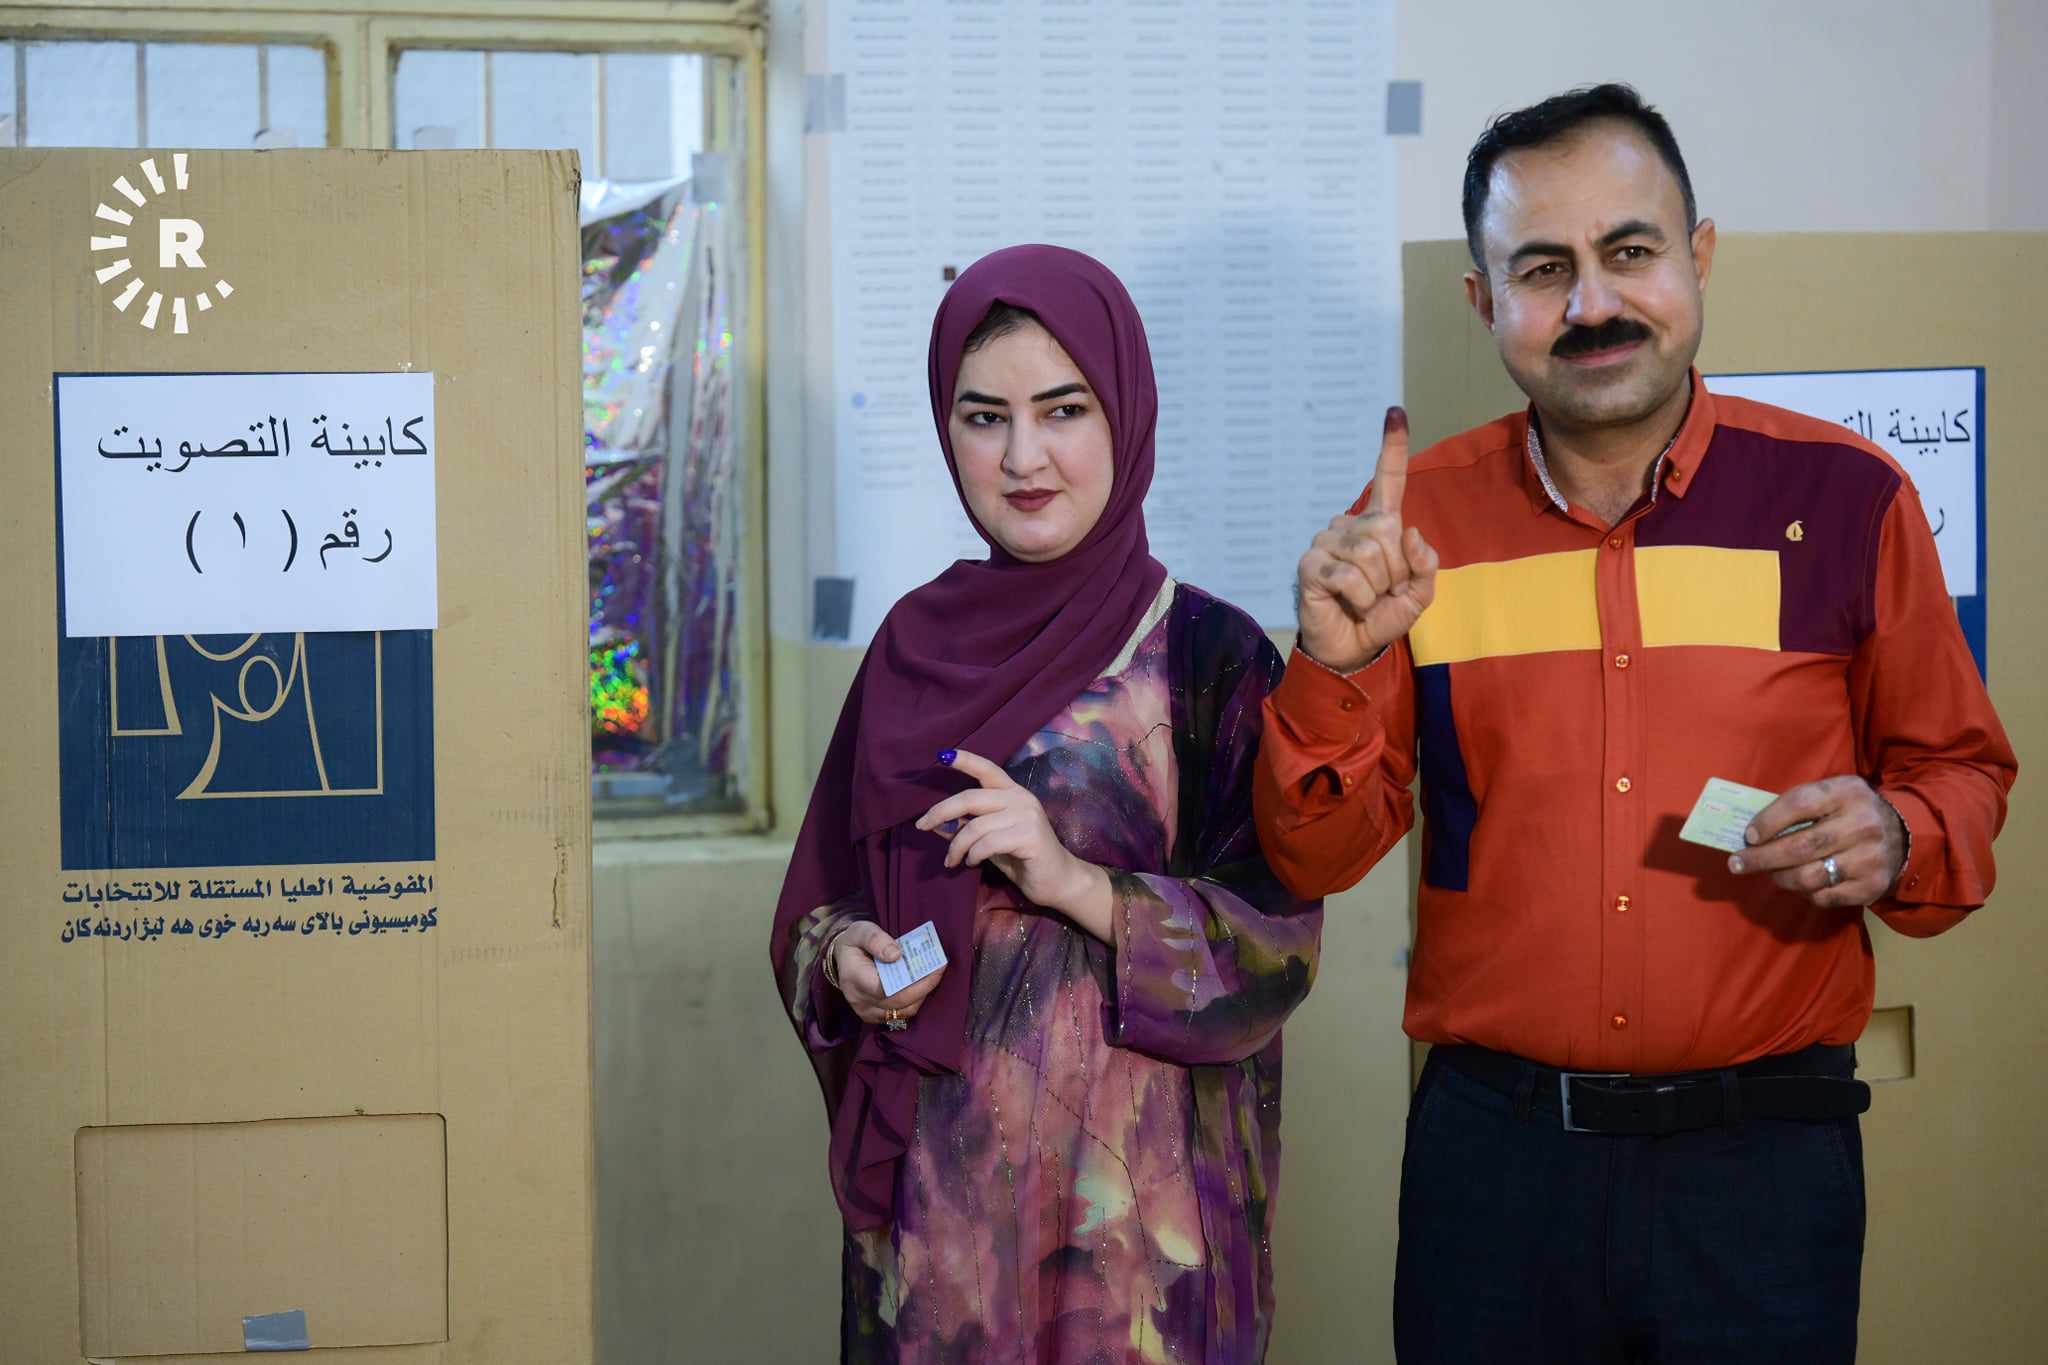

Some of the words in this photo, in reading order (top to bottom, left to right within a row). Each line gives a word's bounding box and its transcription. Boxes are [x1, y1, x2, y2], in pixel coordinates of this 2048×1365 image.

[97, 413, 291, 473] التصويت
[310, 413, 428, 470] كابينة
[1888, 408, 1971, 456] كابينة
[319, 507, 393, 571] رقم
[62, 880, 181, 909] للانتخابات
[188, 878, 272, 899] المستقلة
[280, 876, 333, 903] العليا
[341, 873, 434, 901] المفوضية
